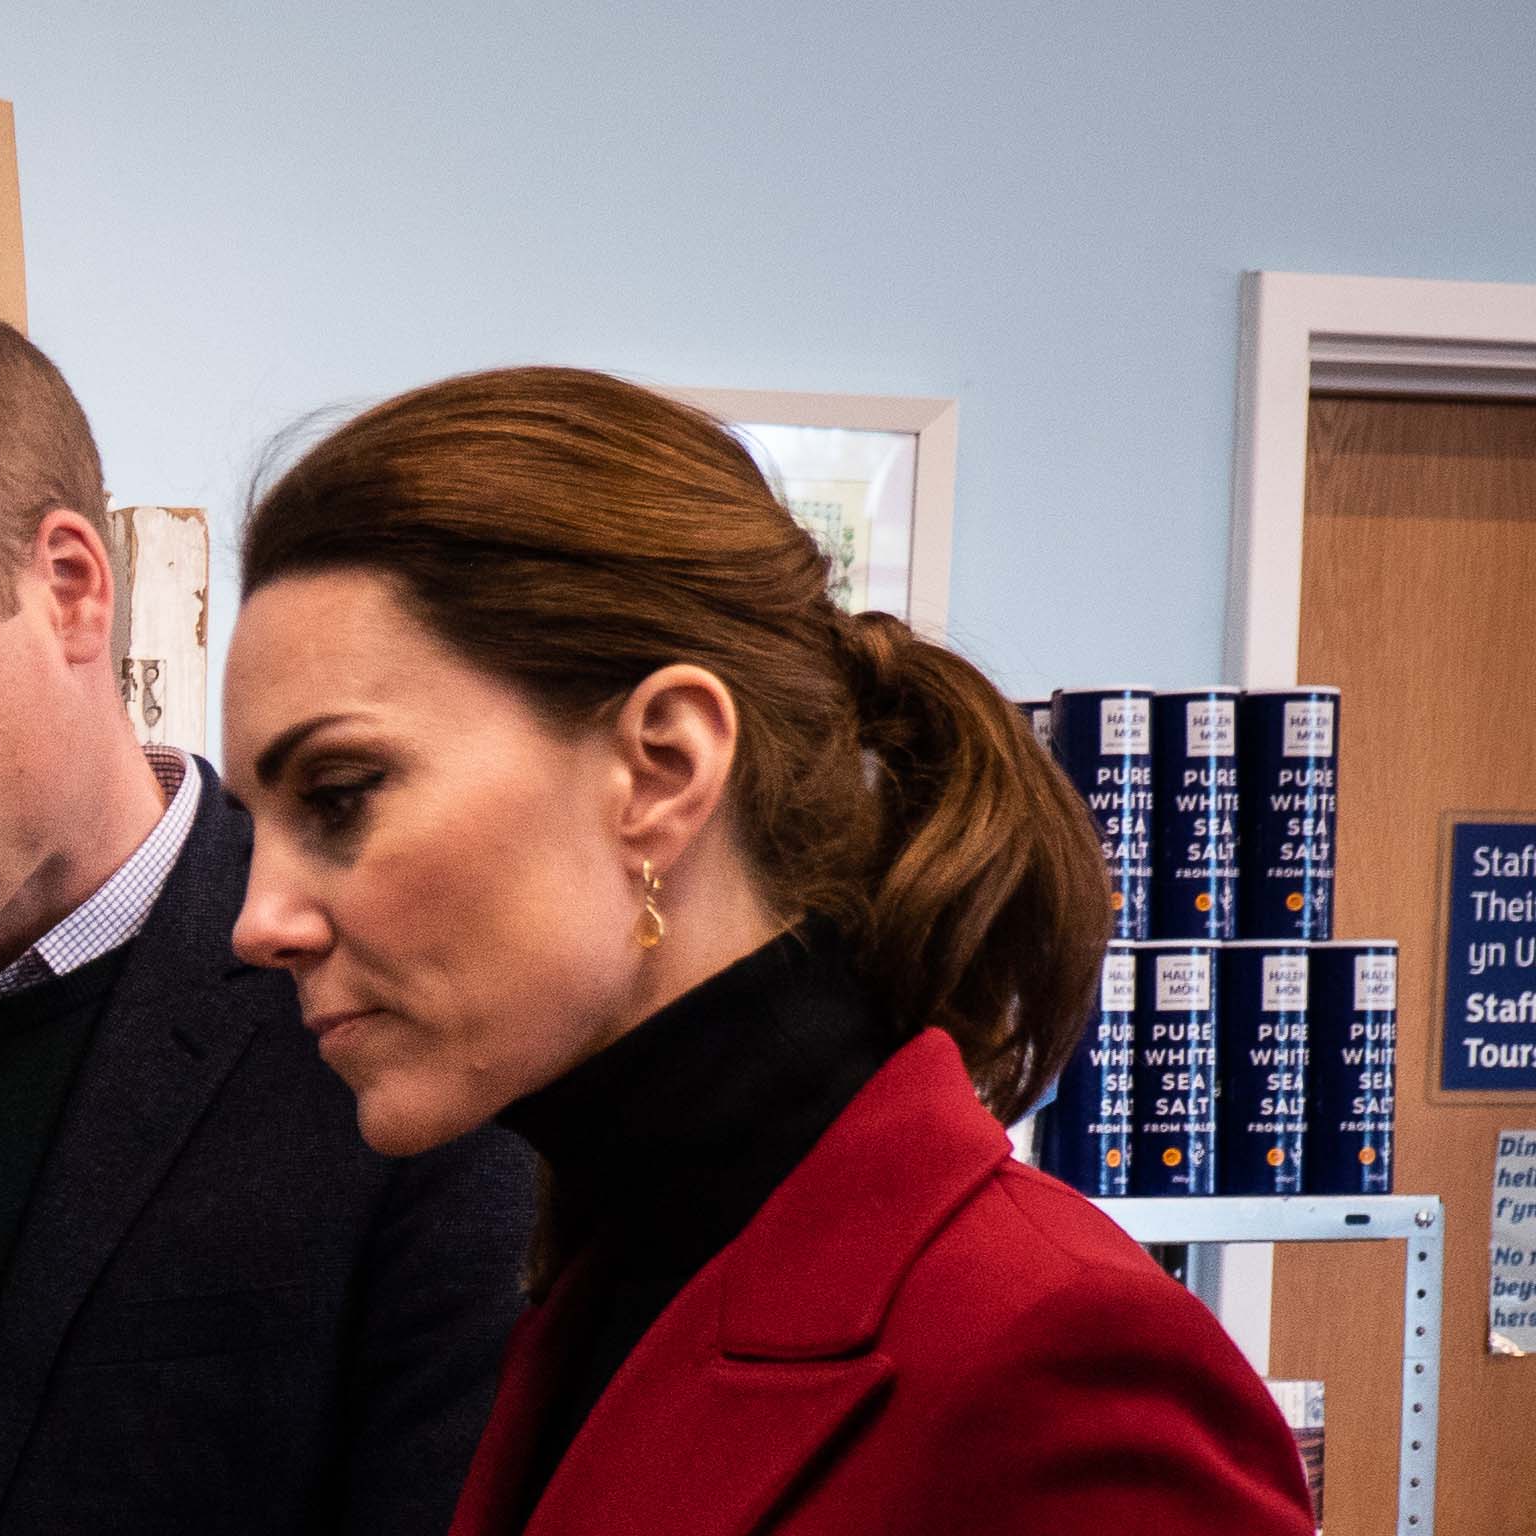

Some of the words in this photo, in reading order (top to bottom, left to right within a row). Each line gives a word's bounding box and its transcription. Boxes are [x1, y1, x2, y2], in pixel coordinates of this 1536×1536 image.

[1183, 769, 1237, 787] PURE
[1278, 769, 1334, 788] PURE
[1176, 793, 1239, 812] WHITE
[1271, 794, 1336, 812] WHITE
[1193, 818, 1233, 836] SEA
[1287, 818, 1327, 836] SEA
[1187, 843, 1236, 862] SALT
[1280, 843, 1330, 862] SALT
[1469, 941, 1505, 975] yn
[1516, 937, 1536, 968] U
[1152, 1024, 1213, 1042] PURE
[1144, 1048, 1216, 1066] WHITE
[1161, 1073, 1206, 1091] SEA
[1155, 1098, 1209, 1115] SALT
[1494, 1248, 1523, 1266] No
